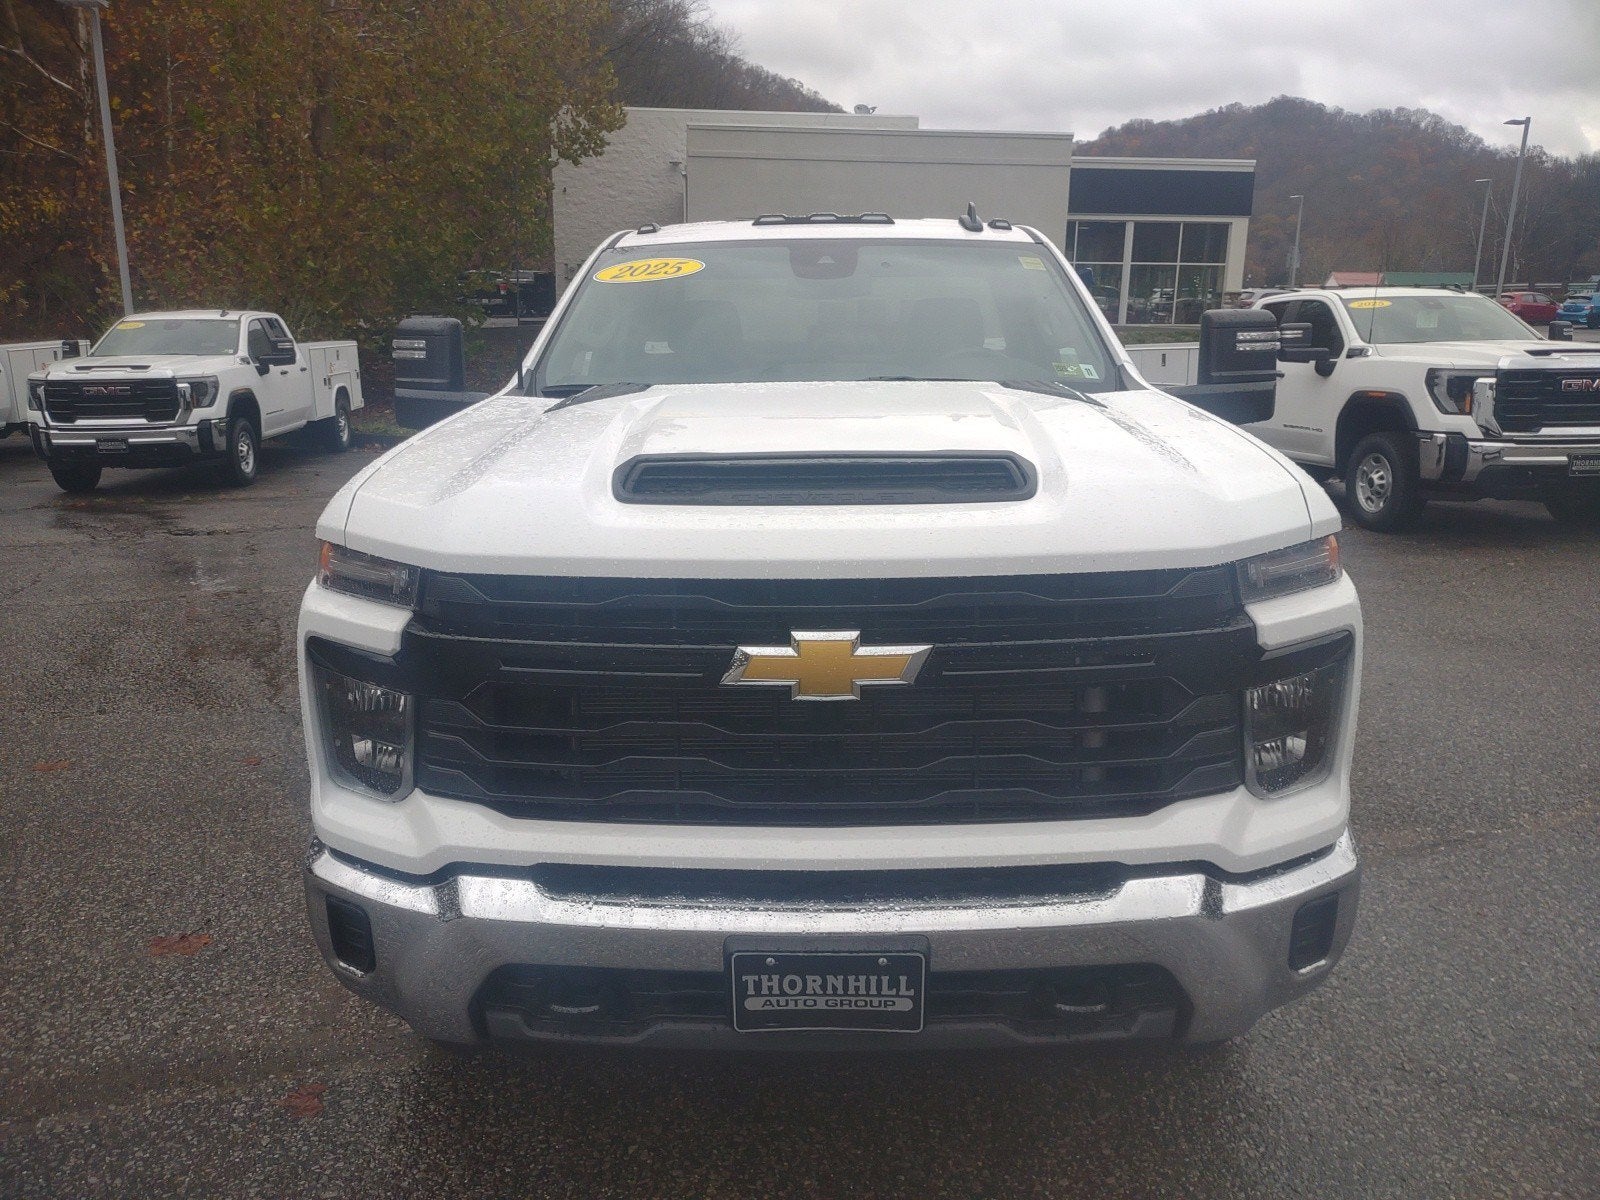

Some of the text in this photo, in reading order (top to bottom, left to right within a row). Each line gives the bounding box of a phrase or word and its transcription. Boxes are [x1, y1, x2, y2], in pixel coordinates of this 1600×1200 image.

[610, 261, 690, 280] 2025
[83, 386, 131, 396] GMC
[742, 974, 915, 996] THORNHILL
[761, 999, 897, 1009] AUTO GROUP
